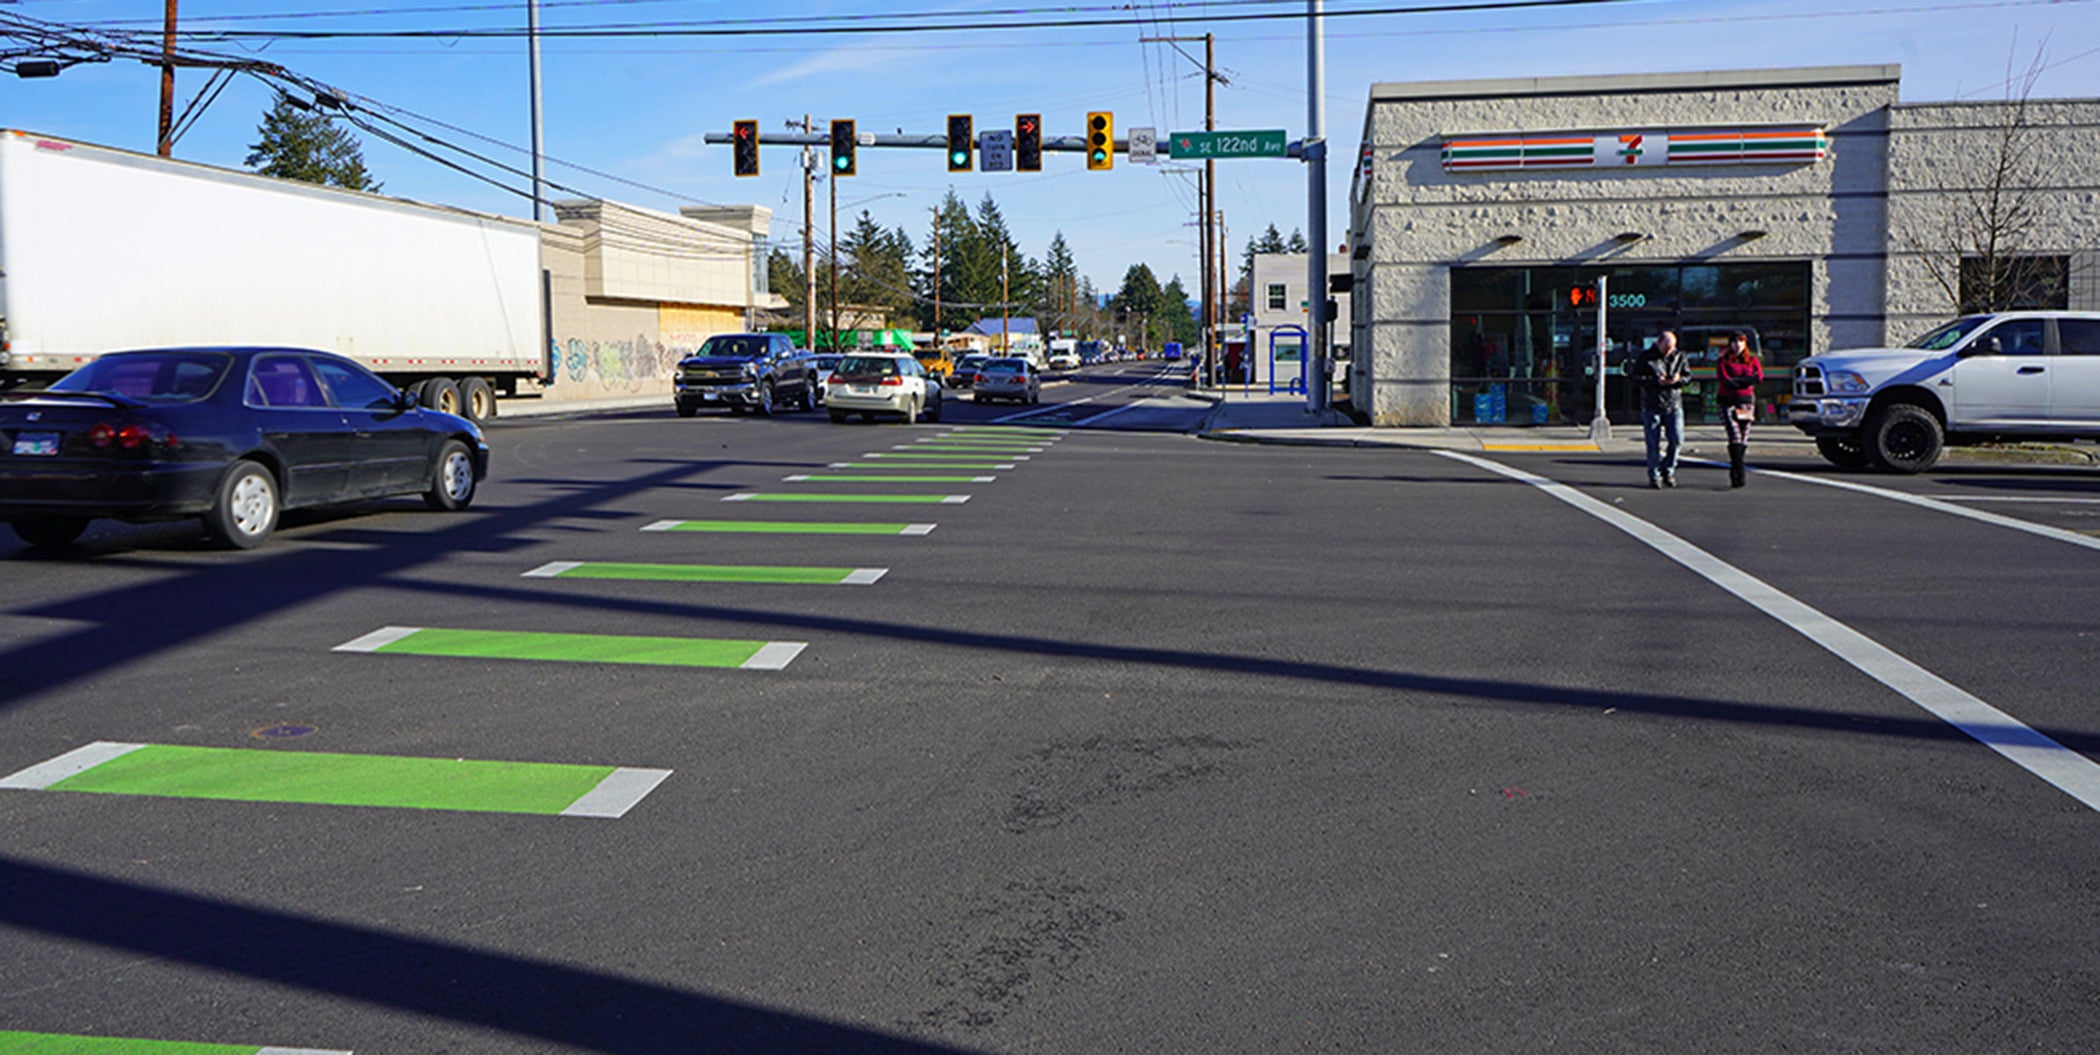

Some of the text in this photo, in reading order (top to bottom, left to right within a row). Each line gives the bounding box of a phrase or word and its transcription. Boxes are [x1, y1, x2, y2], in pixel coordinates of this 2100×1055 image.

[1217, 136, 1257, 153] 122nd
[1263, 141, 1282, 152] Ave
[1609, 293, 1646, 308] 3500
